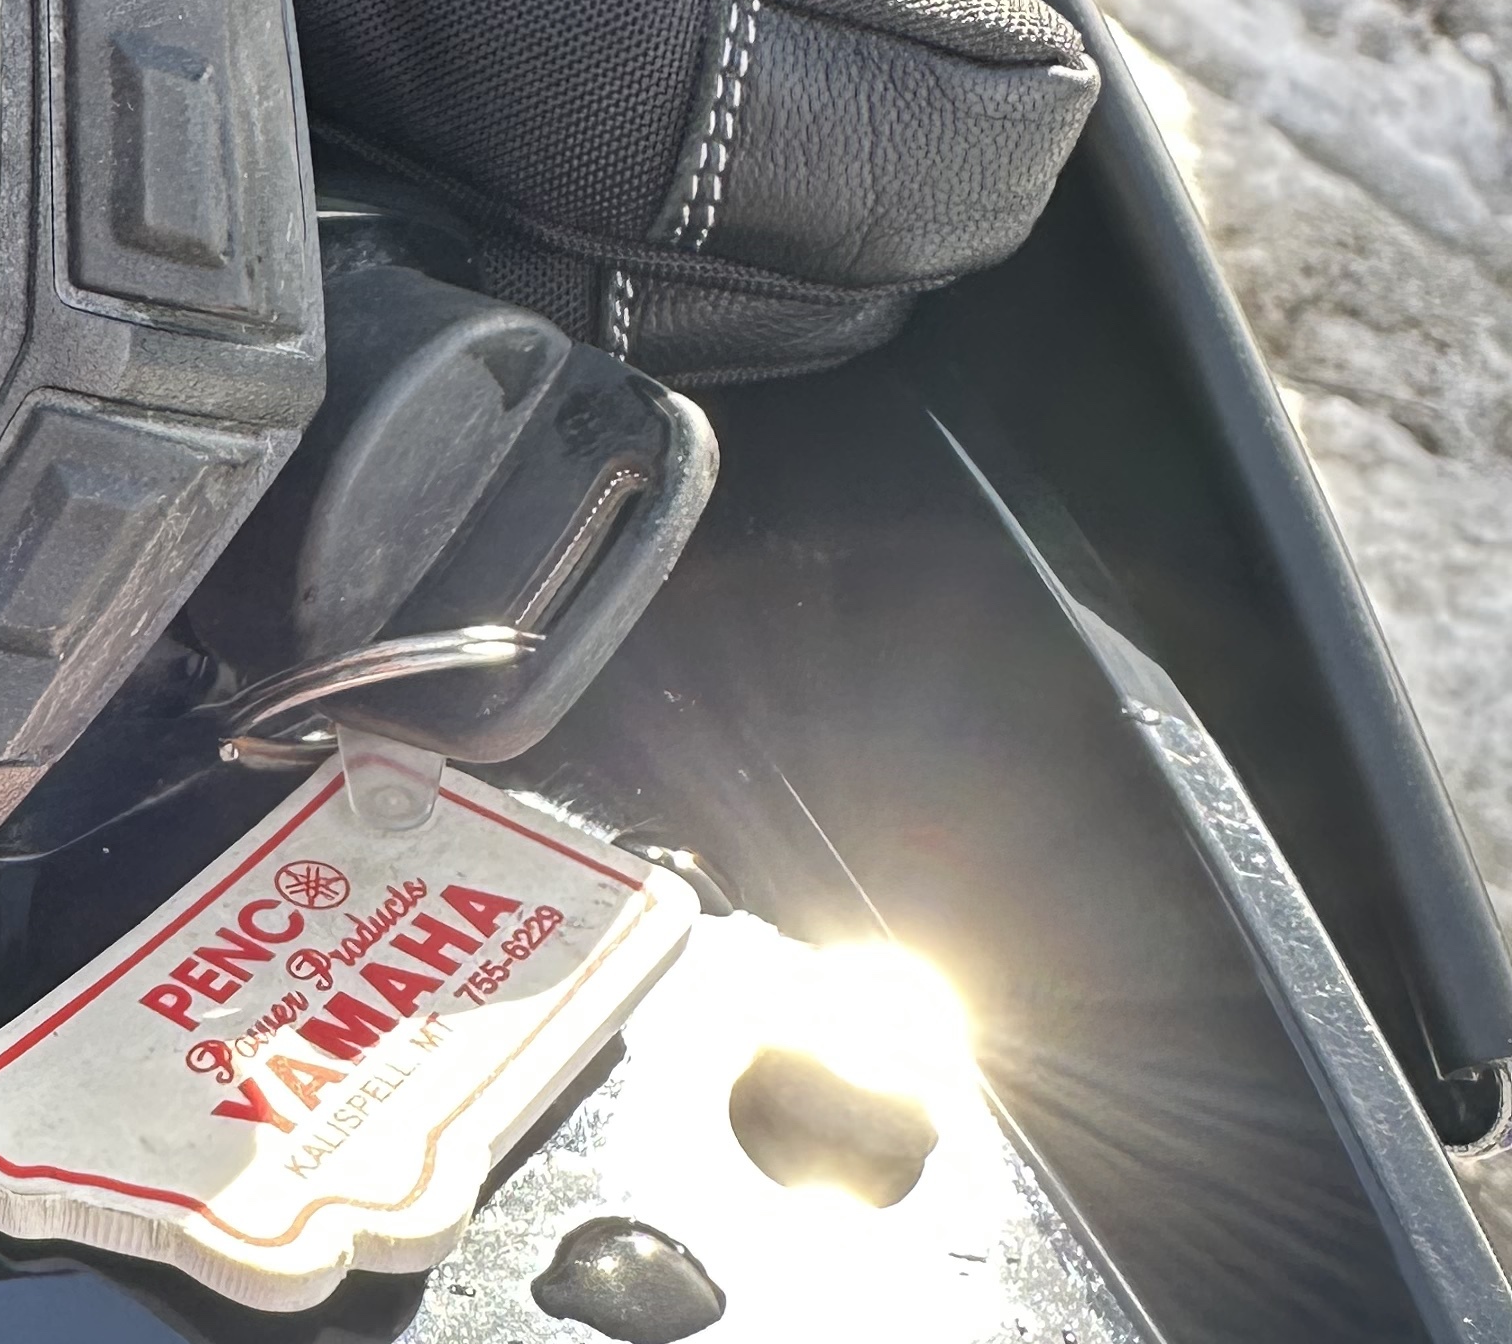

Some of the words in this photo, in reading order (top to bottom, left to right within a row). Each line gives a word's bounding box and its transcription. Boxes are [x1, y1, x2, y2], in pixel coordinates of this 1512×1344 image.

[185, 991, 310, 1085] Power
[285, 877, 428, 992] Products
[211, 885, 524, 1135] YAMAHA
[409, 1011, 454, 1053] MT
[453, 905, 565, 1006] 755-6229
